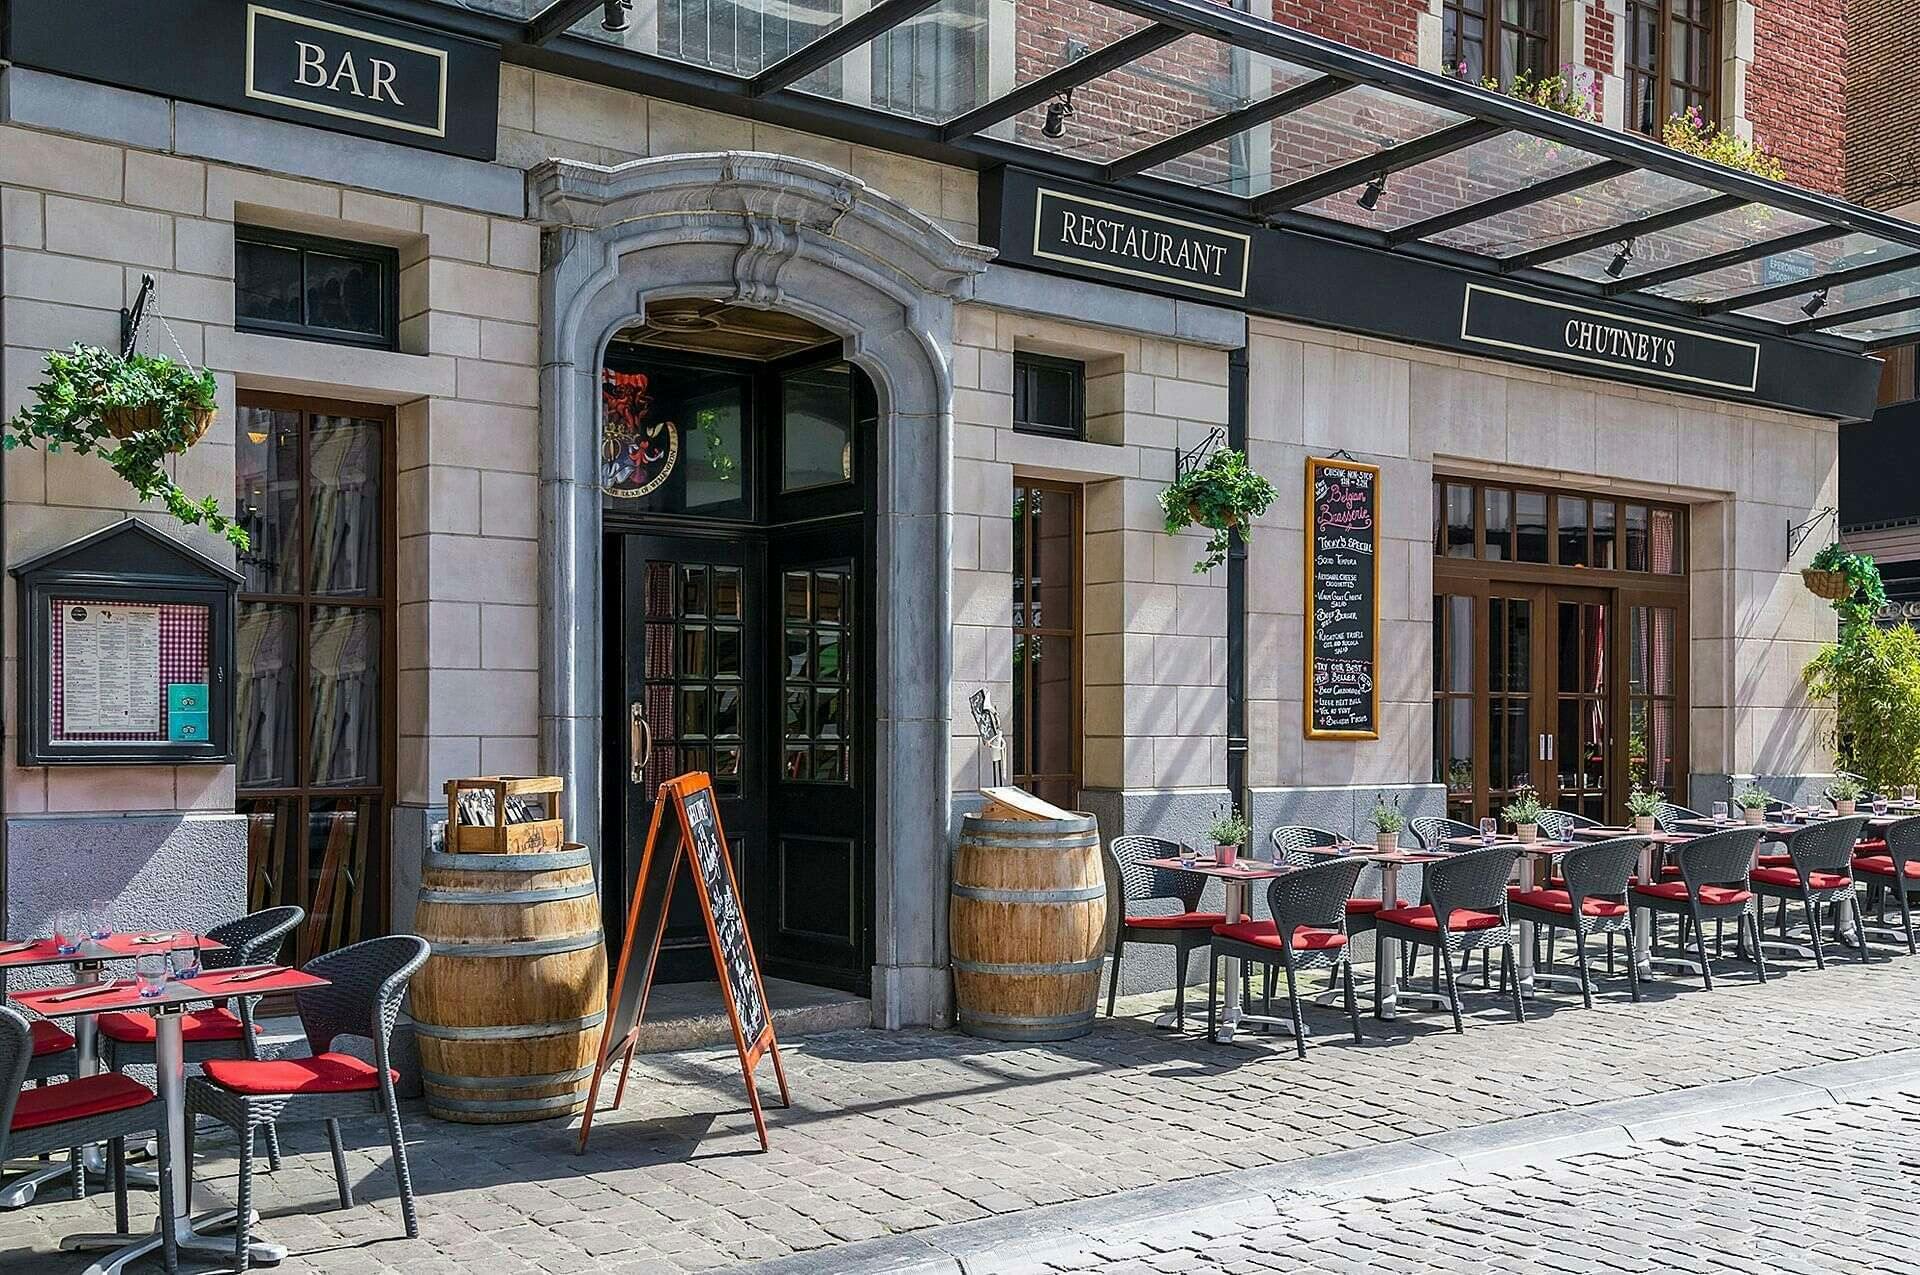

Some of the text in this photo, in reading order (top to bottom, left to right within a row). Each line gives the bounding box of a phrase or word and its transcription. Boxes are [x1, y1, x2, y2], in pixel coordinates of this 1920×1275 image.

[294, 40, 405, 106] BAR
[1060, 210, 1228, 277] RESTAURANT
[1564, 319, 1676, 367] CHUTNEY'S
[1327, 484, 1366, 510] Belgian
[1317, 504, 1370, 524] Brasserie
[1331, 663, 1344, 671] OUR
[1345, 664, 1362, 672] BEST
[1331, 672, 1357, 682] SELLER
